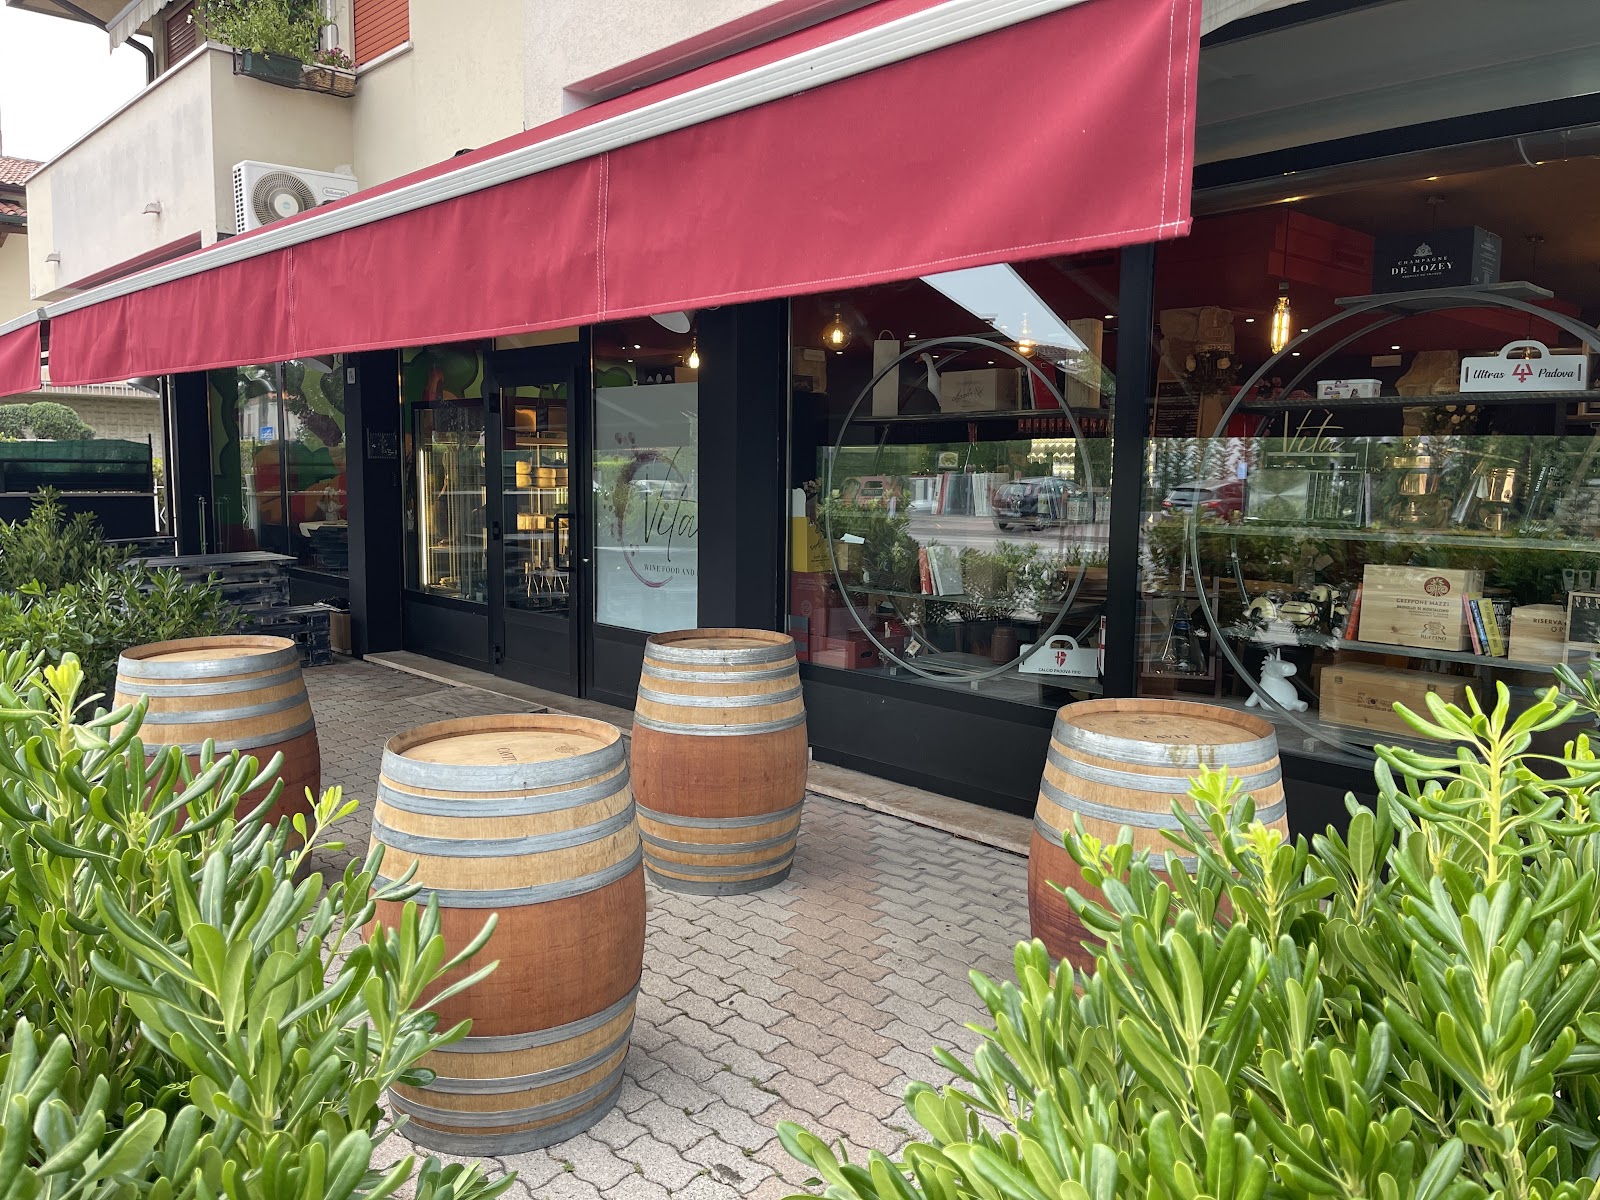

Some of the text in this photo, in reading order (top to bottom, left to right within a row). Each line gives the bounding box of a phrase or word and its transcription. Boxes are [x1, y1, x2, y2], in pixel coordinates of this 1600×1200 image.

[1397, 255, 1448, 266] CHAMPAGNE
[1391, 261, 1454, 276] DE LOZEY
[1473, 367, 1575, 380] Ultras Padova
[643, 563, 695, 577] WINE FOOD AND
[1533, 617, 1563, 626] RISERVA
